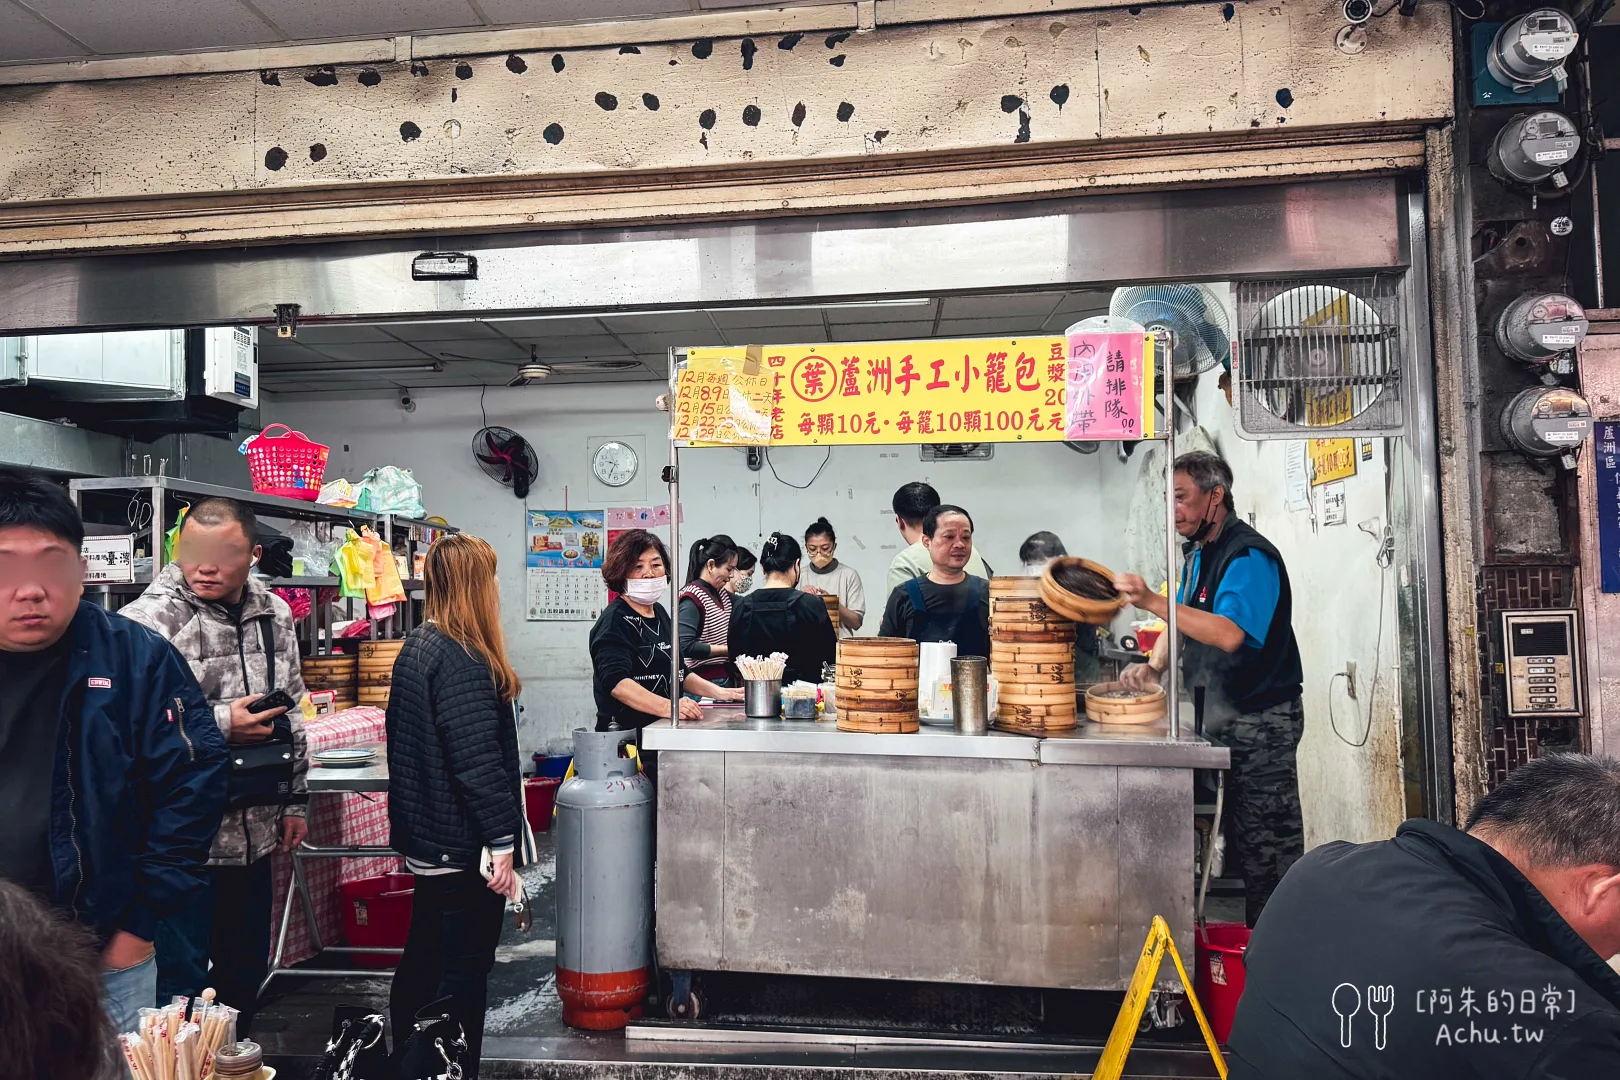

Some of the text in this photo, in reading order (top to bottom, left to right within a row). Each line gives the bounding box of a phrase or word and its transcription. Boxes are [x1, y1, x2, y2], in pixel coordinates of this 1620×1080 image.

[801, 362, 826, 396] 葉
[839, 352, 1040, 396] 蘆洲手工小籠包
[768, 356, 785, 440] 四十年老店
[1603, 425, 1616, 469] 蘆洲區
